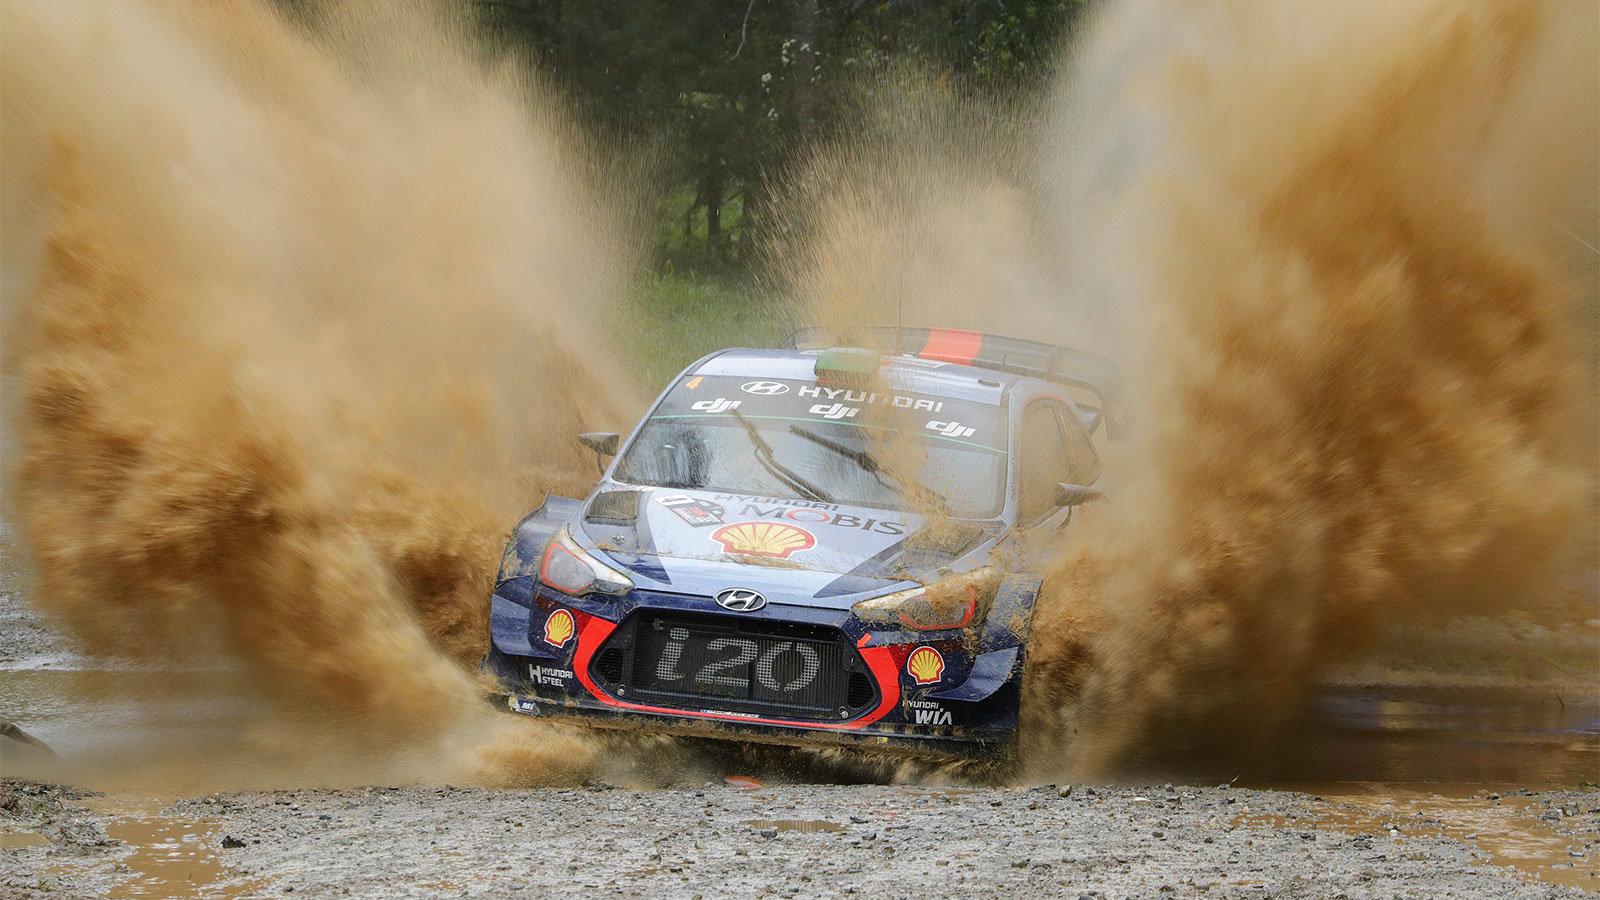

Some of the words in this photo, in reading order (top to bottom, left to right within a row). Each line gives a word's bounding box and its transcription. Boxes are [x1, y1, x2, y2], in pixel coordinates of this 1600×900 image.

[739, 504, 905, 535] MOBIS
[655, 627, 820, 692] i20
[542, 667, 573, 679] HYUNDAI
[542, 676, 564, 687] STEEL
[915, 708, 953, 725] WIA
